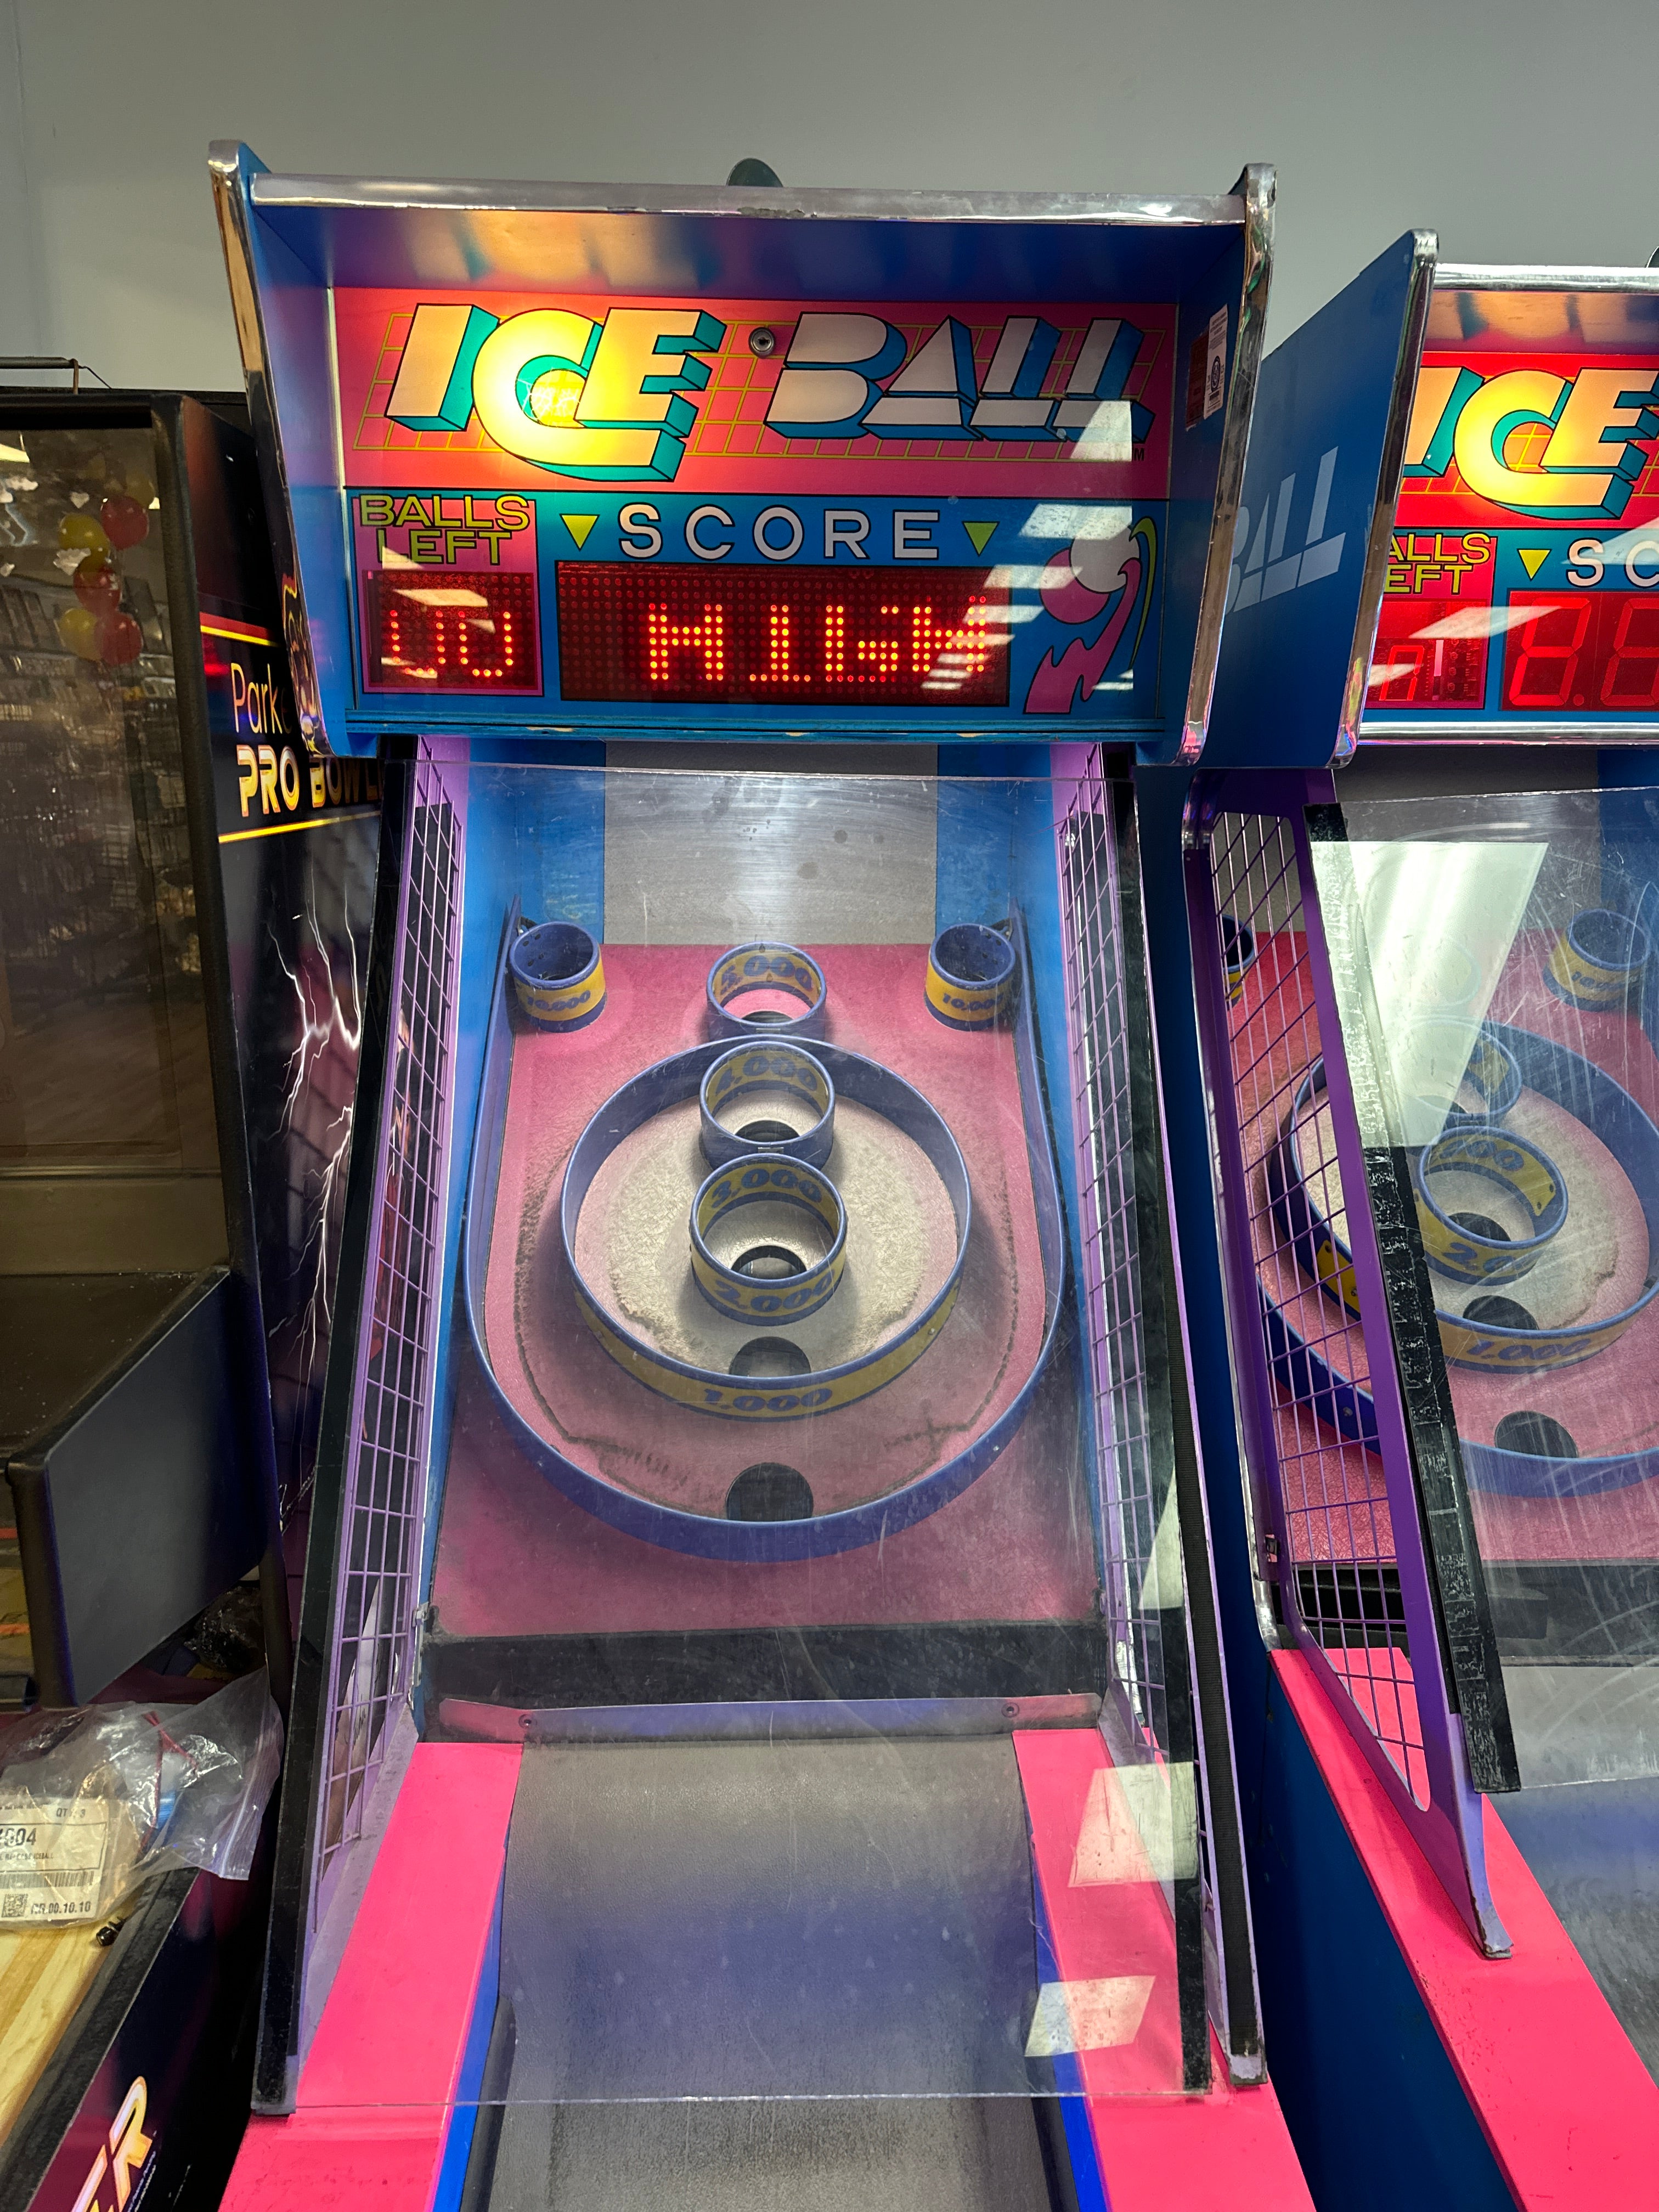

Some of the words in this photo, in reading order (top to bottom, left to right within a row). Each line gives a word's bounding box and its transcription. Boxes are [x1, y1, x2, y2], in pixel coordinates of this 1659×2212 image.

[384, 303, 727, 482] ICE
[763, 311, 1156, 443] BALL
[1403, 366, 1659, 520] ICE
[360, 493, 530, 531] BALLS
[618, 501, 940, 561] SCORE
[376, 527, 512, 566] LEFT
[1383, 563, 1474, 595] EFT
[236, 744, 301, 817] PRO
